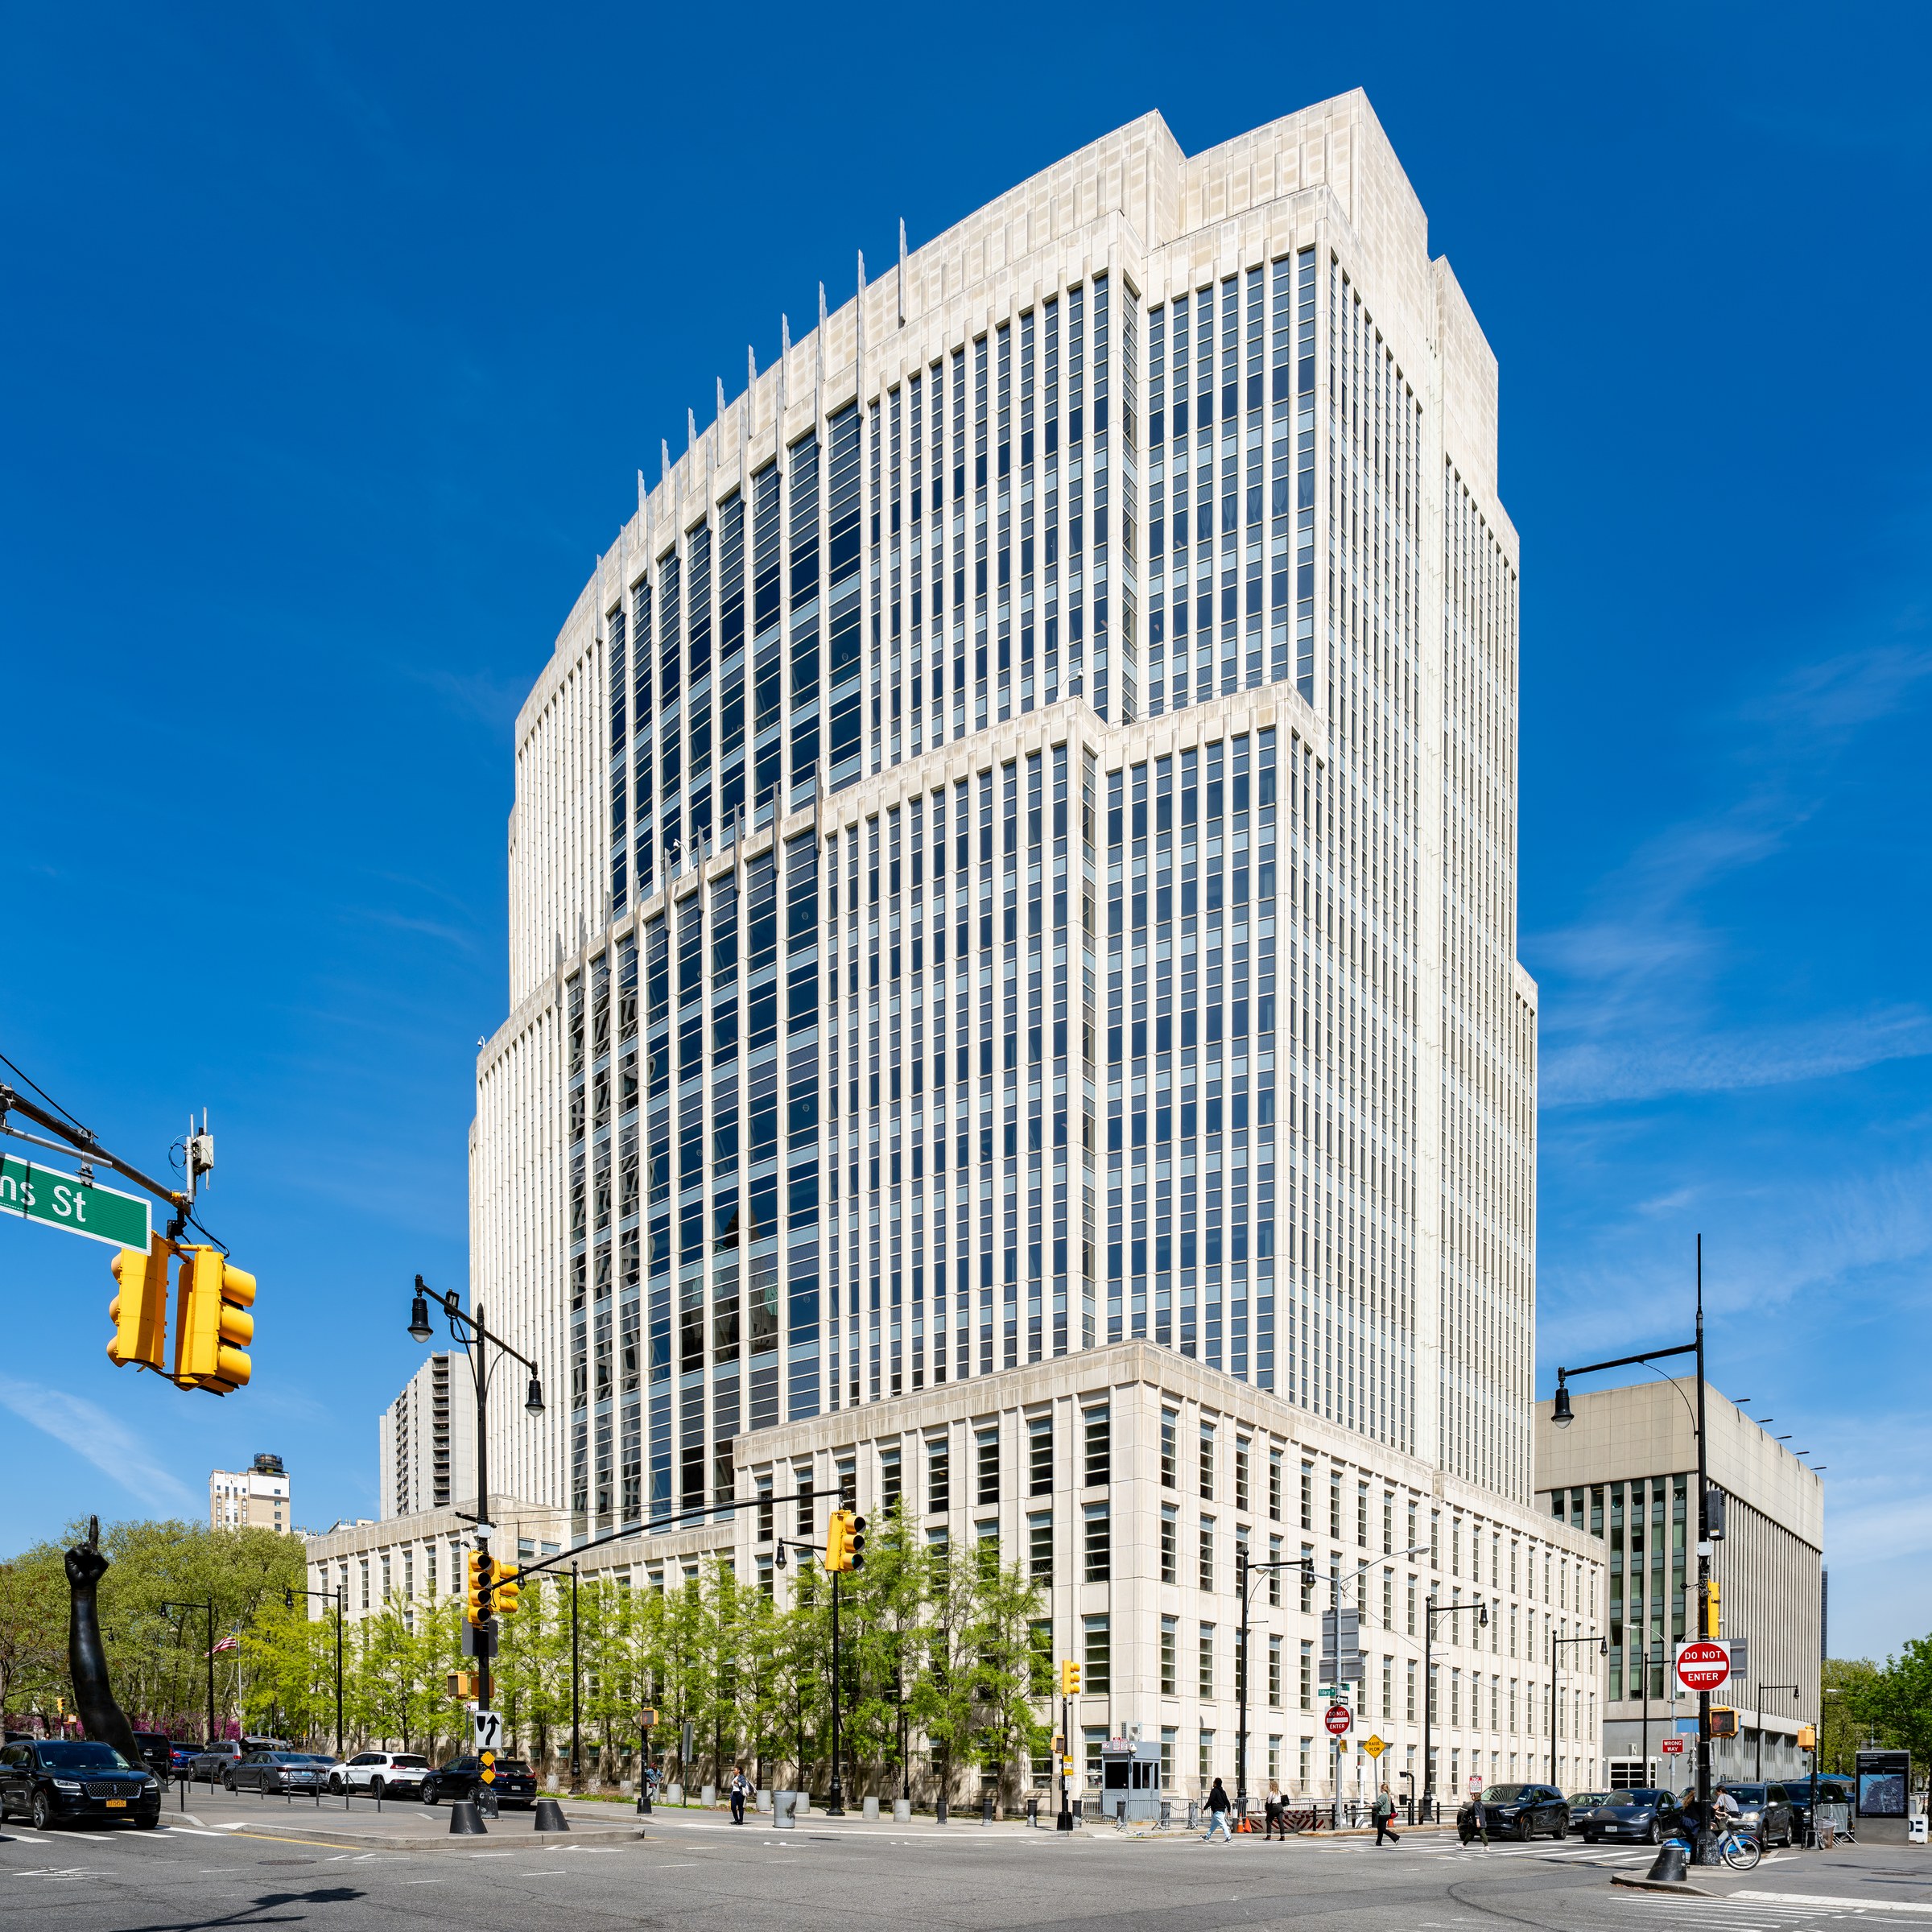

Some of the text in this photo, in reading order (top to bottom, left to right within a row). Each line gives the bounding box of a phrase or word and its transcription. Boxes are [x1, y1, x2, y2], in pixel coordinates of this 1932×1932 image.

[52, 1185, 86, 1222] St
[1685, 1650, 1721, 1660] DO NOT
[1688, 1673, 1719, 1682] ENTER
